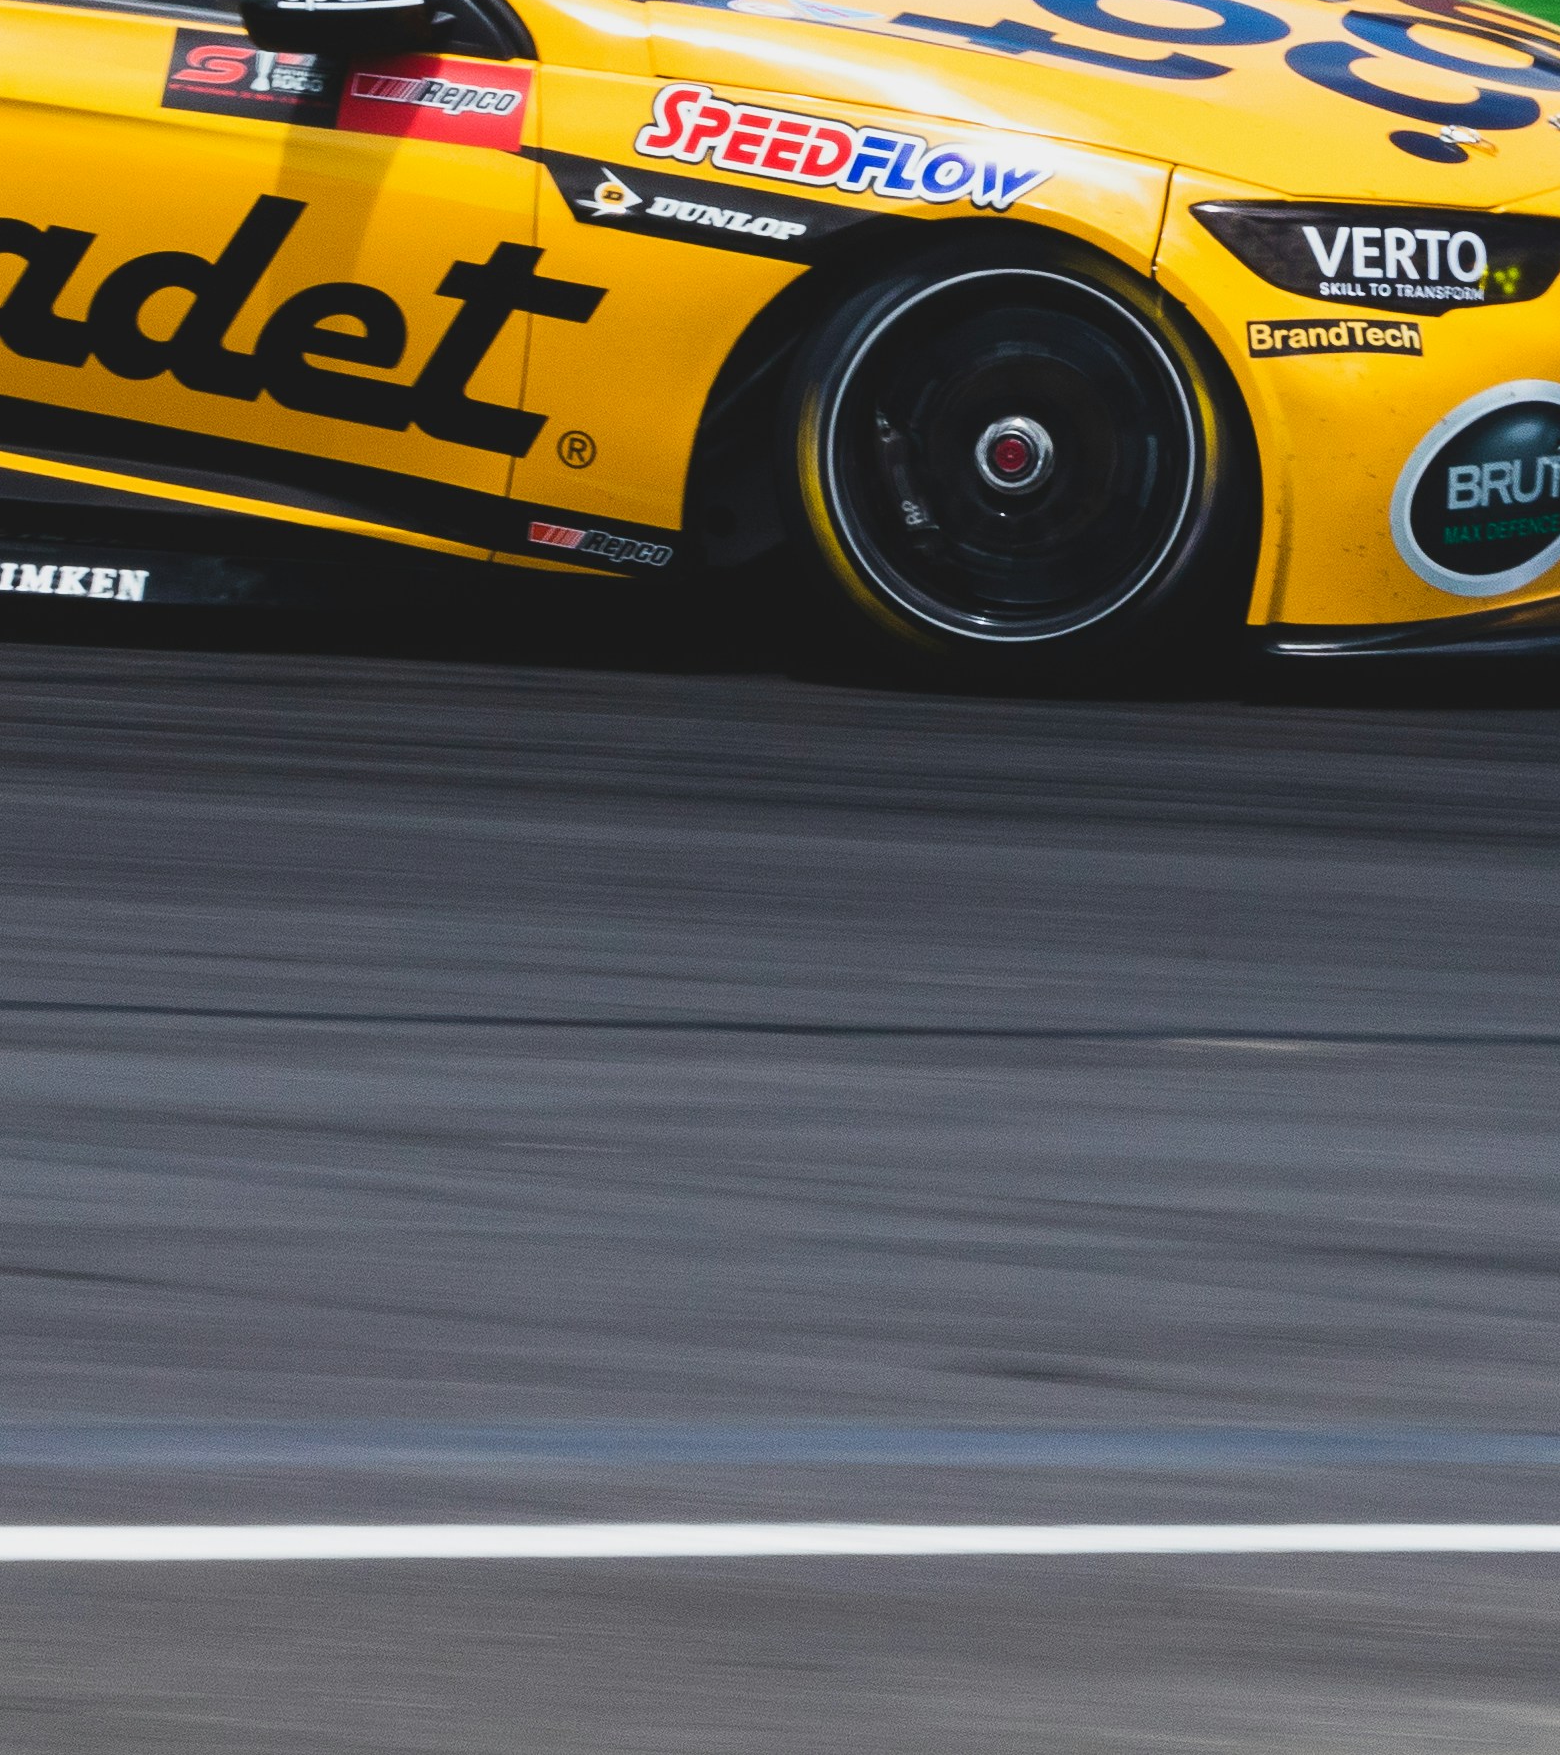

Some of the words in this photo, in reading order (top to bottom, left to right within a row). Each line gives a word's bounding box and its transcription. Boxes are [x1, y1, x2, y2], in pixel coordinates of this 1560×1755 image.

[419, 76, 522, 118] Repco
[636, 83, 1053, 212] SPEEDFLOW
[645, 196, 807, 241] DUNLOP
[1302, 225, 1488, 283] VERTO
[1319, 281, 1366, 297] SKILL
[1369, 282, 1392, 297] TO
[1396, 283, 1485, 302] TRANSFORM
[1250, 321, 1421, 352] BrandTech
[580, 529, 674, 566] Repco
[1443, 525, 1482, 545] MAX
